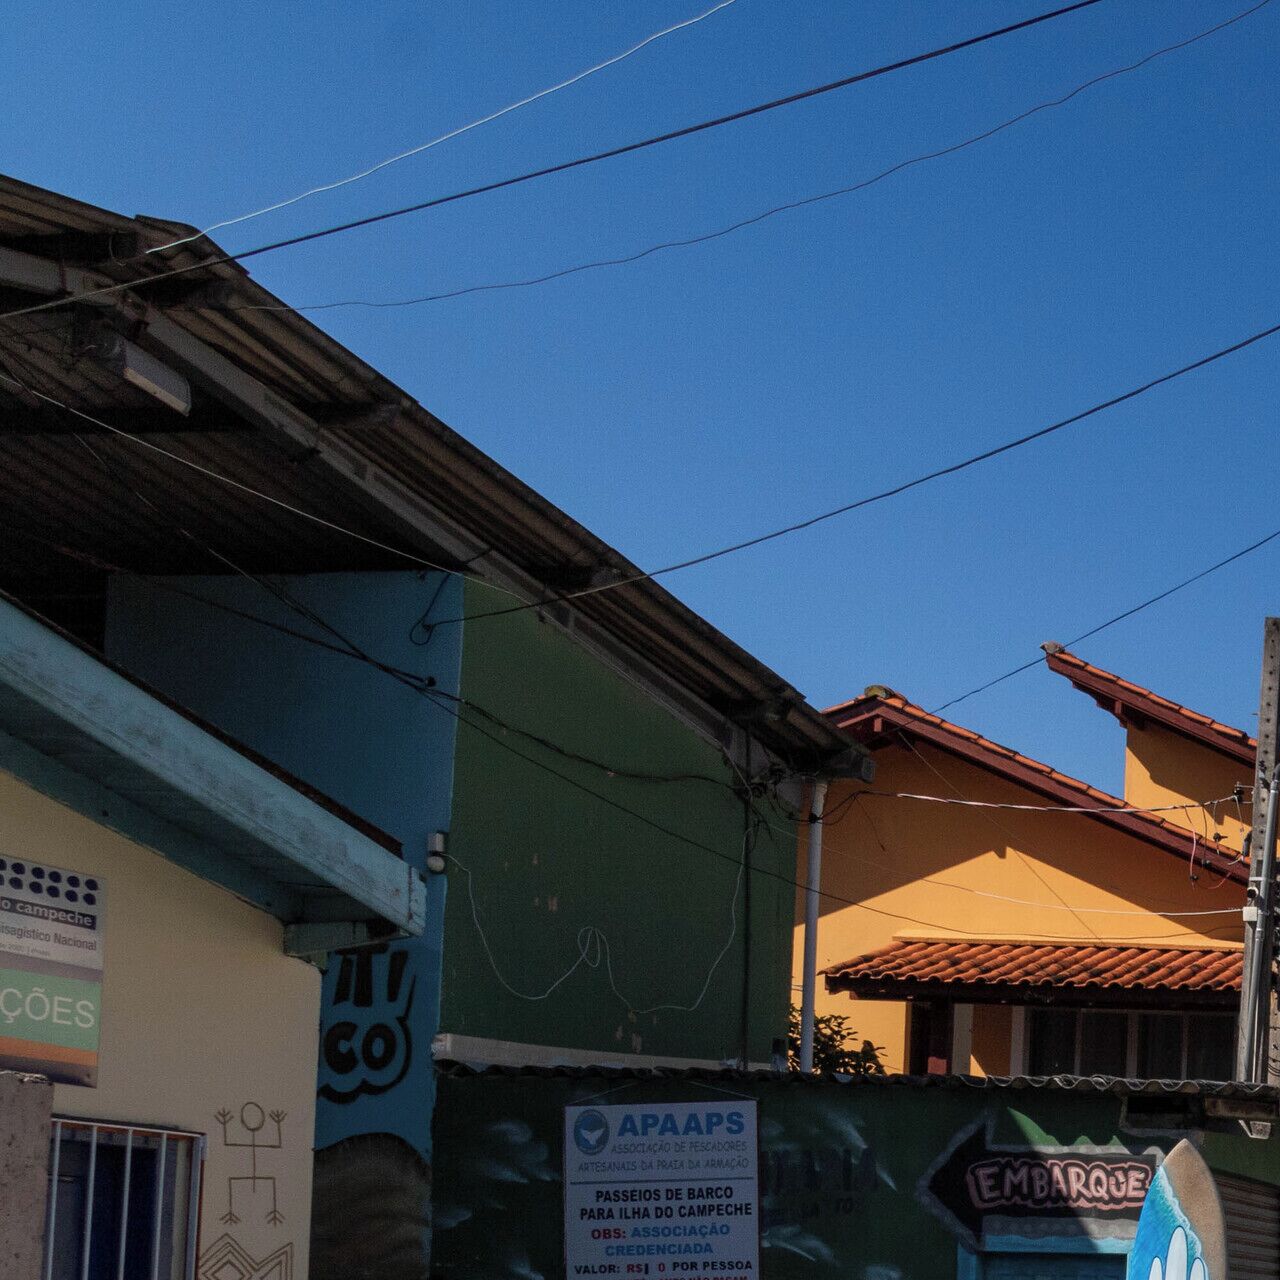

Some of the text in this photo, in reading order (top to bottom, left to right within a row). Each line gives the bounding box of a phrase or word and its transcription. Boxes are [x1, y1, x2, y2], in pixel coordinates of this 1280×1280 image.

[16, 903, 92, 926] campeche
[53, 932, 96, 951] Nacional
[617, 1111, 745, 1137] APAAPS
[611, 1140, 748, 1154] ASSOCIAÇÃO DE PESCADORES
[578, 1155, 749, 1173] ARTESANAIS DA PRAIA DA ARMAÇÃO
[975, 1163, 1146, 1202] EMBARQUE
[596, 1186, 733, 1203] PASSEIOS DE BARCO
[581, 1207, 615, 1220] PARA
[619, 1206, 652, 1219] ILHA
[655, 1205, 674, 1218] DO
[678, 1203, 752, 1217] CAMPECHE
[591, 1223, 731, 1240] OBS: ASSOCIAÇÃO
[605, 1242, 714, 1257] CREDENCIADA
[574, 1264, 620, 1275] VALOR:
[672, 1261, 698, 1272] POR
[702, 1260, 752, 1271] PESSOA
